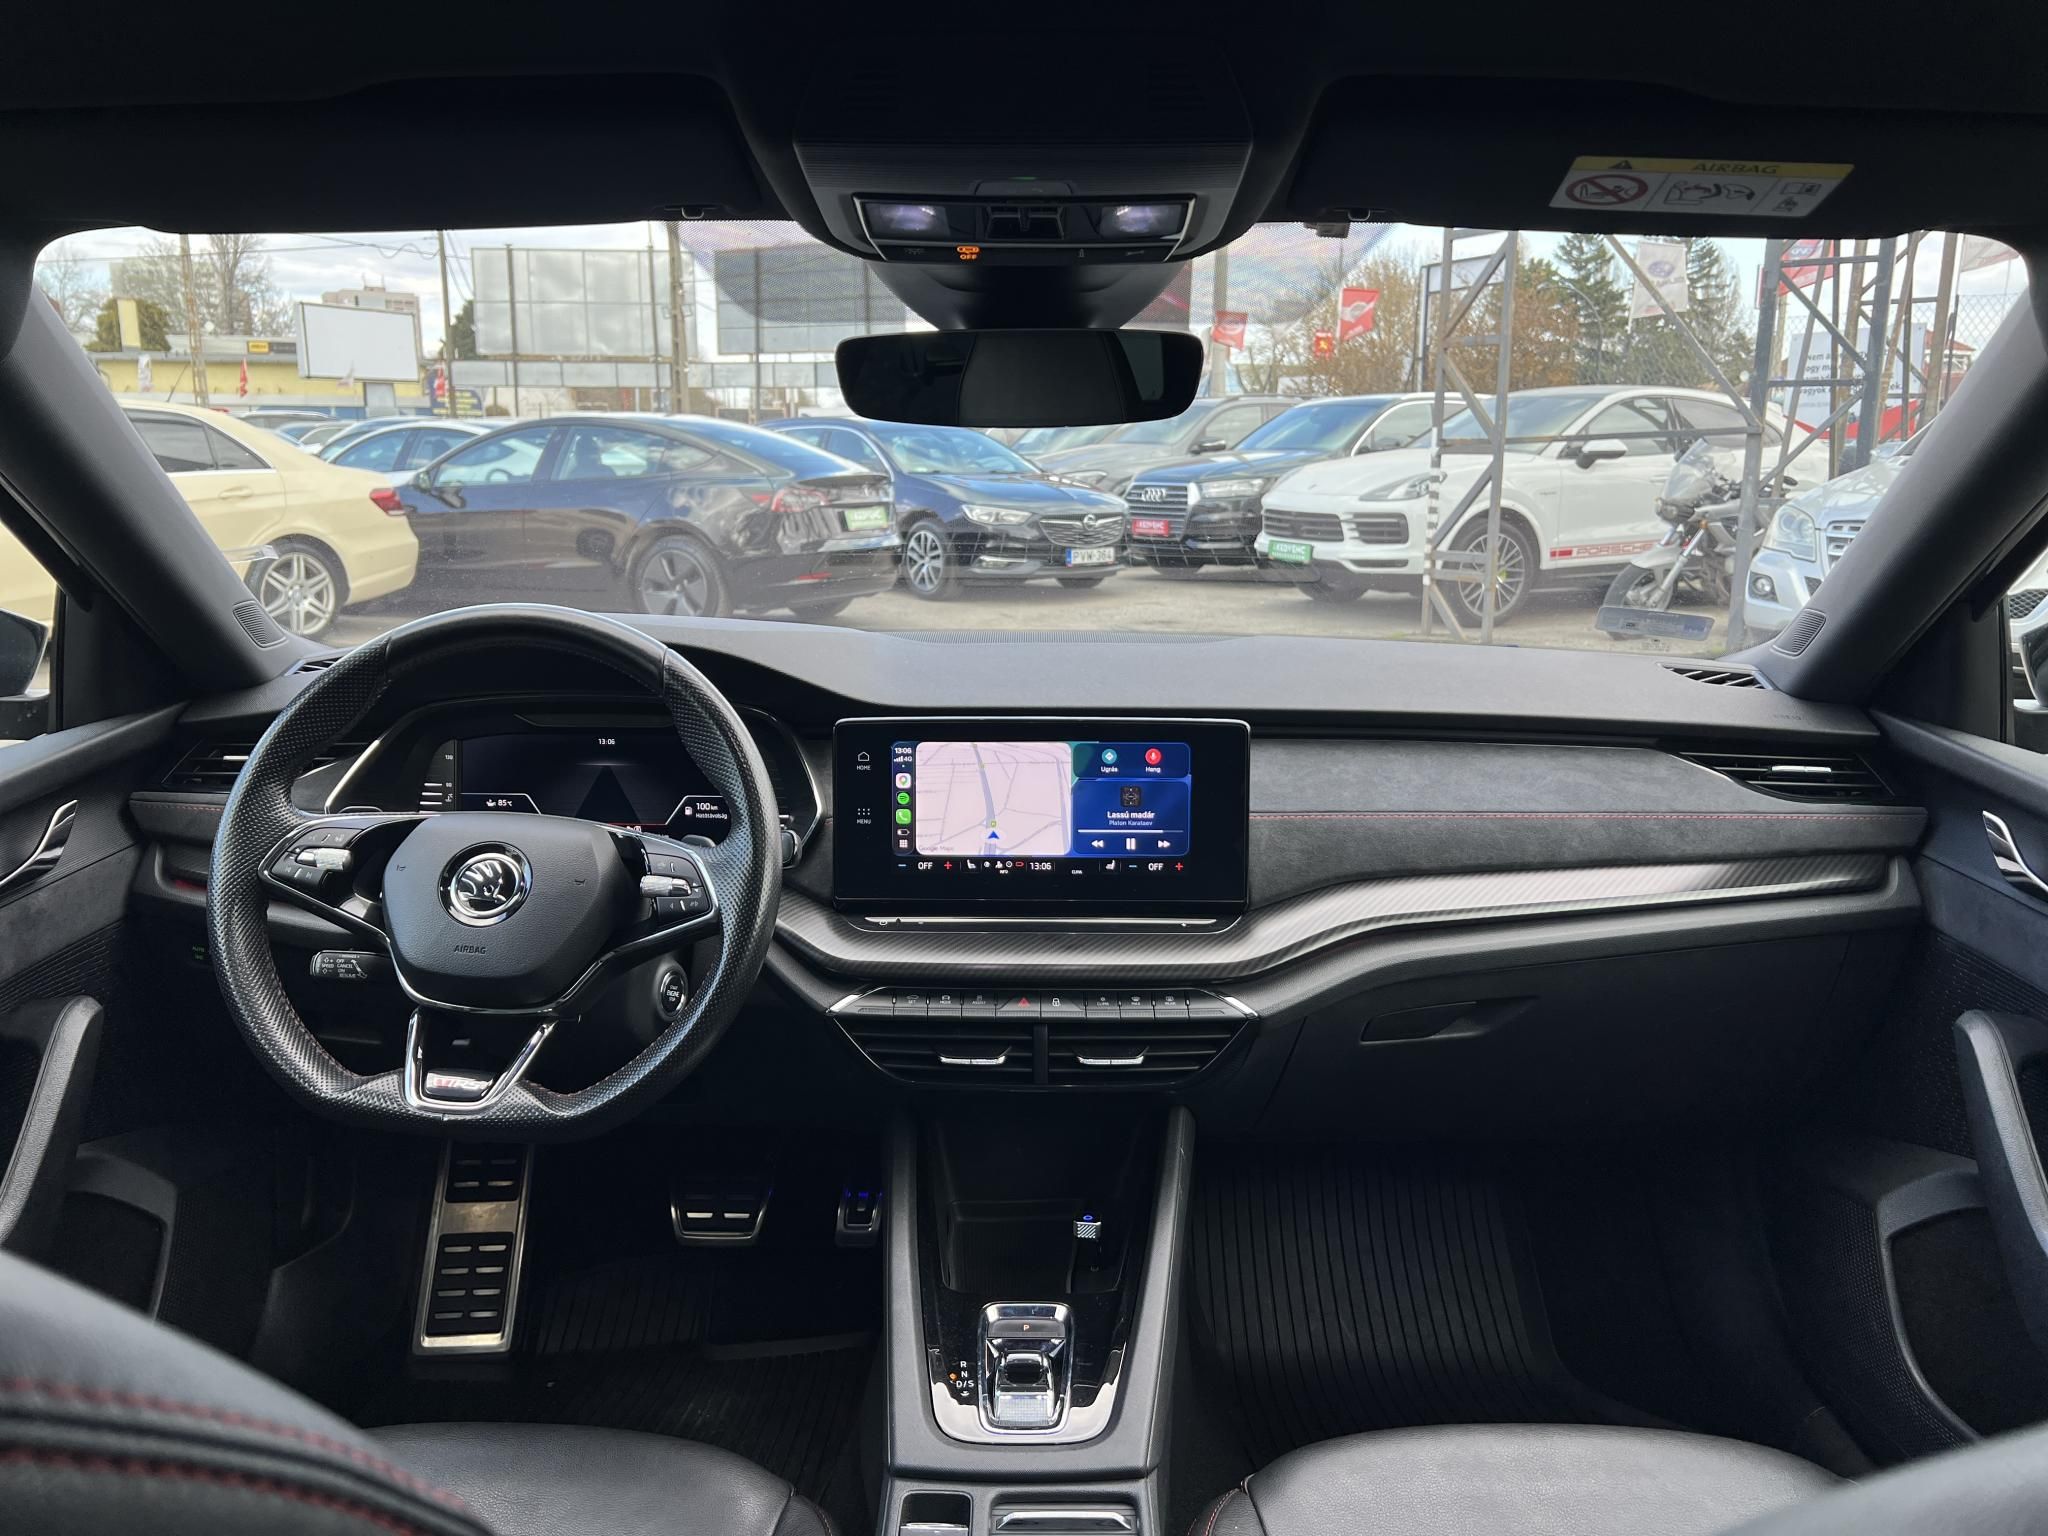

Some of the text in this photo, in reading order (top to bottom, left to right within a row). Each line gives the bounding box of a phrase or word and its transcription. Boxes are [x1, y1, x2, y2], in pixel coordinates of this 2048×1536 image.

[1692, 162, 1779, 174] AIRBAG
[1107, 811, 1156, 819] Lassú madár
[917, 862, 933, 870] OFF
[1029, 862, 1052, 870] 13:06
[1148, 862, 1164, 871] OFF
[454, 945, 486, 954] AIRBAG
[961, 1370, 968, 1378] N
[956, 1380, 974, 1388] D/S
